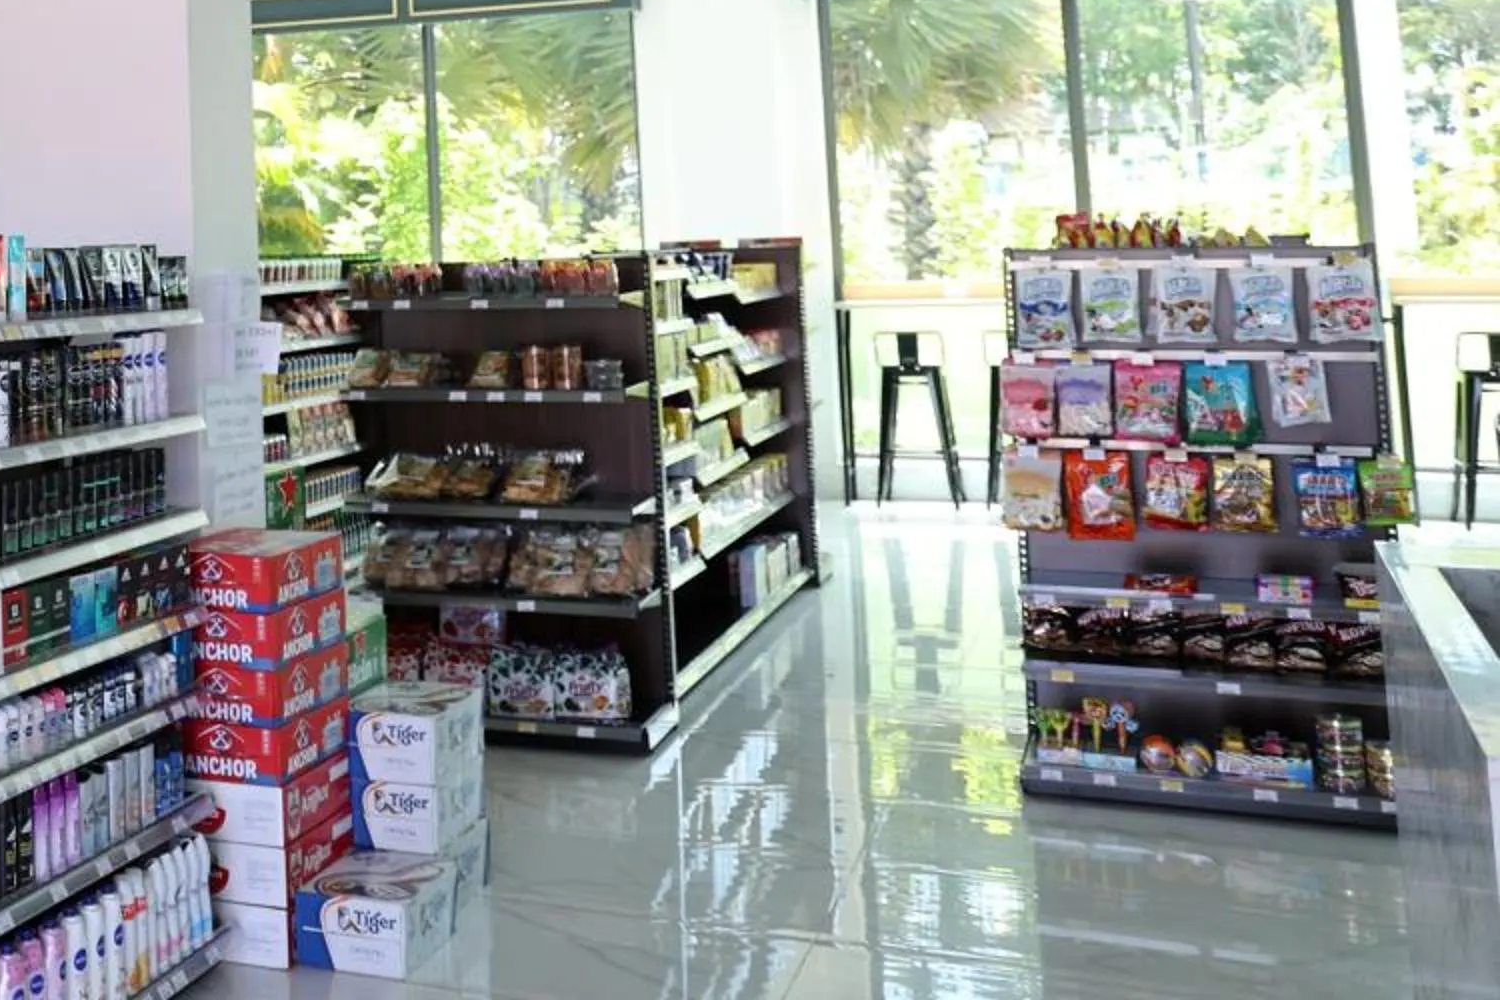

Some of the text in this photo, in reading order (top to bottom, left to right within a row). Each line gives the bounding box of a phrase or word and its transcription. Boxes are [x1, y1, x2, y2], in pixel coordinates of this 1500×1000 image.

[386, 722, 427, 746] Tiger
[185, 754, 257, 780] ANCHOR
[389, 791, 430, 815] Tiger
[353, 909, 398, 934] Tiger
